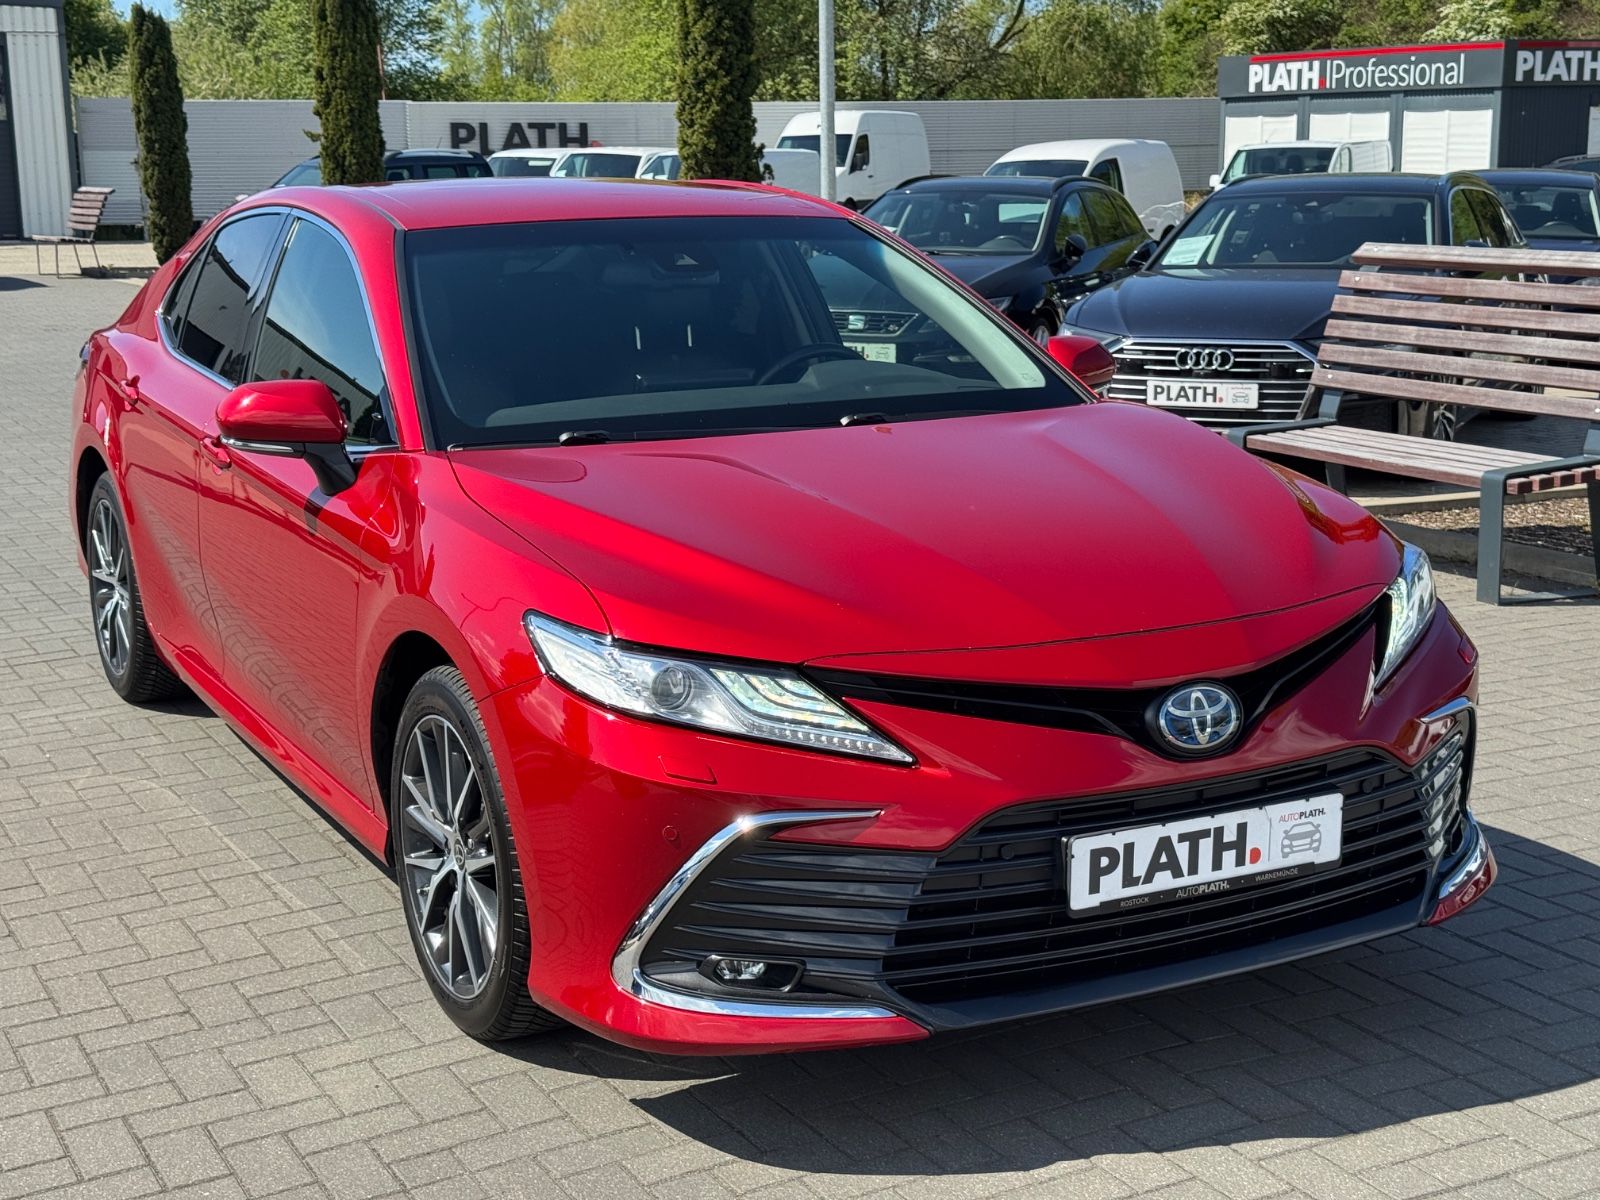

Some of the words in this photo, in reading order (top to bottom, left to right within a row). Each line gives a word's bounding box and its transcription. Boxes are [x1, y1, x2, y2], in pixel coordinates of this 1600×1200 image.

[1515, 50, 1600, 81] PLATH
[1153, 384, 1224, 404] PLATH.
[1278, 807, 1326, 823] AUTOPLATH.
[1088, 821, 1261, 896] PLATH.
[1120, 896, 1149, 908] ROSTOCK
[1175, 880, 1230, 898] AUTOPLATH.
[1255, 867, 1299, 882] WARNEMÜNDE
